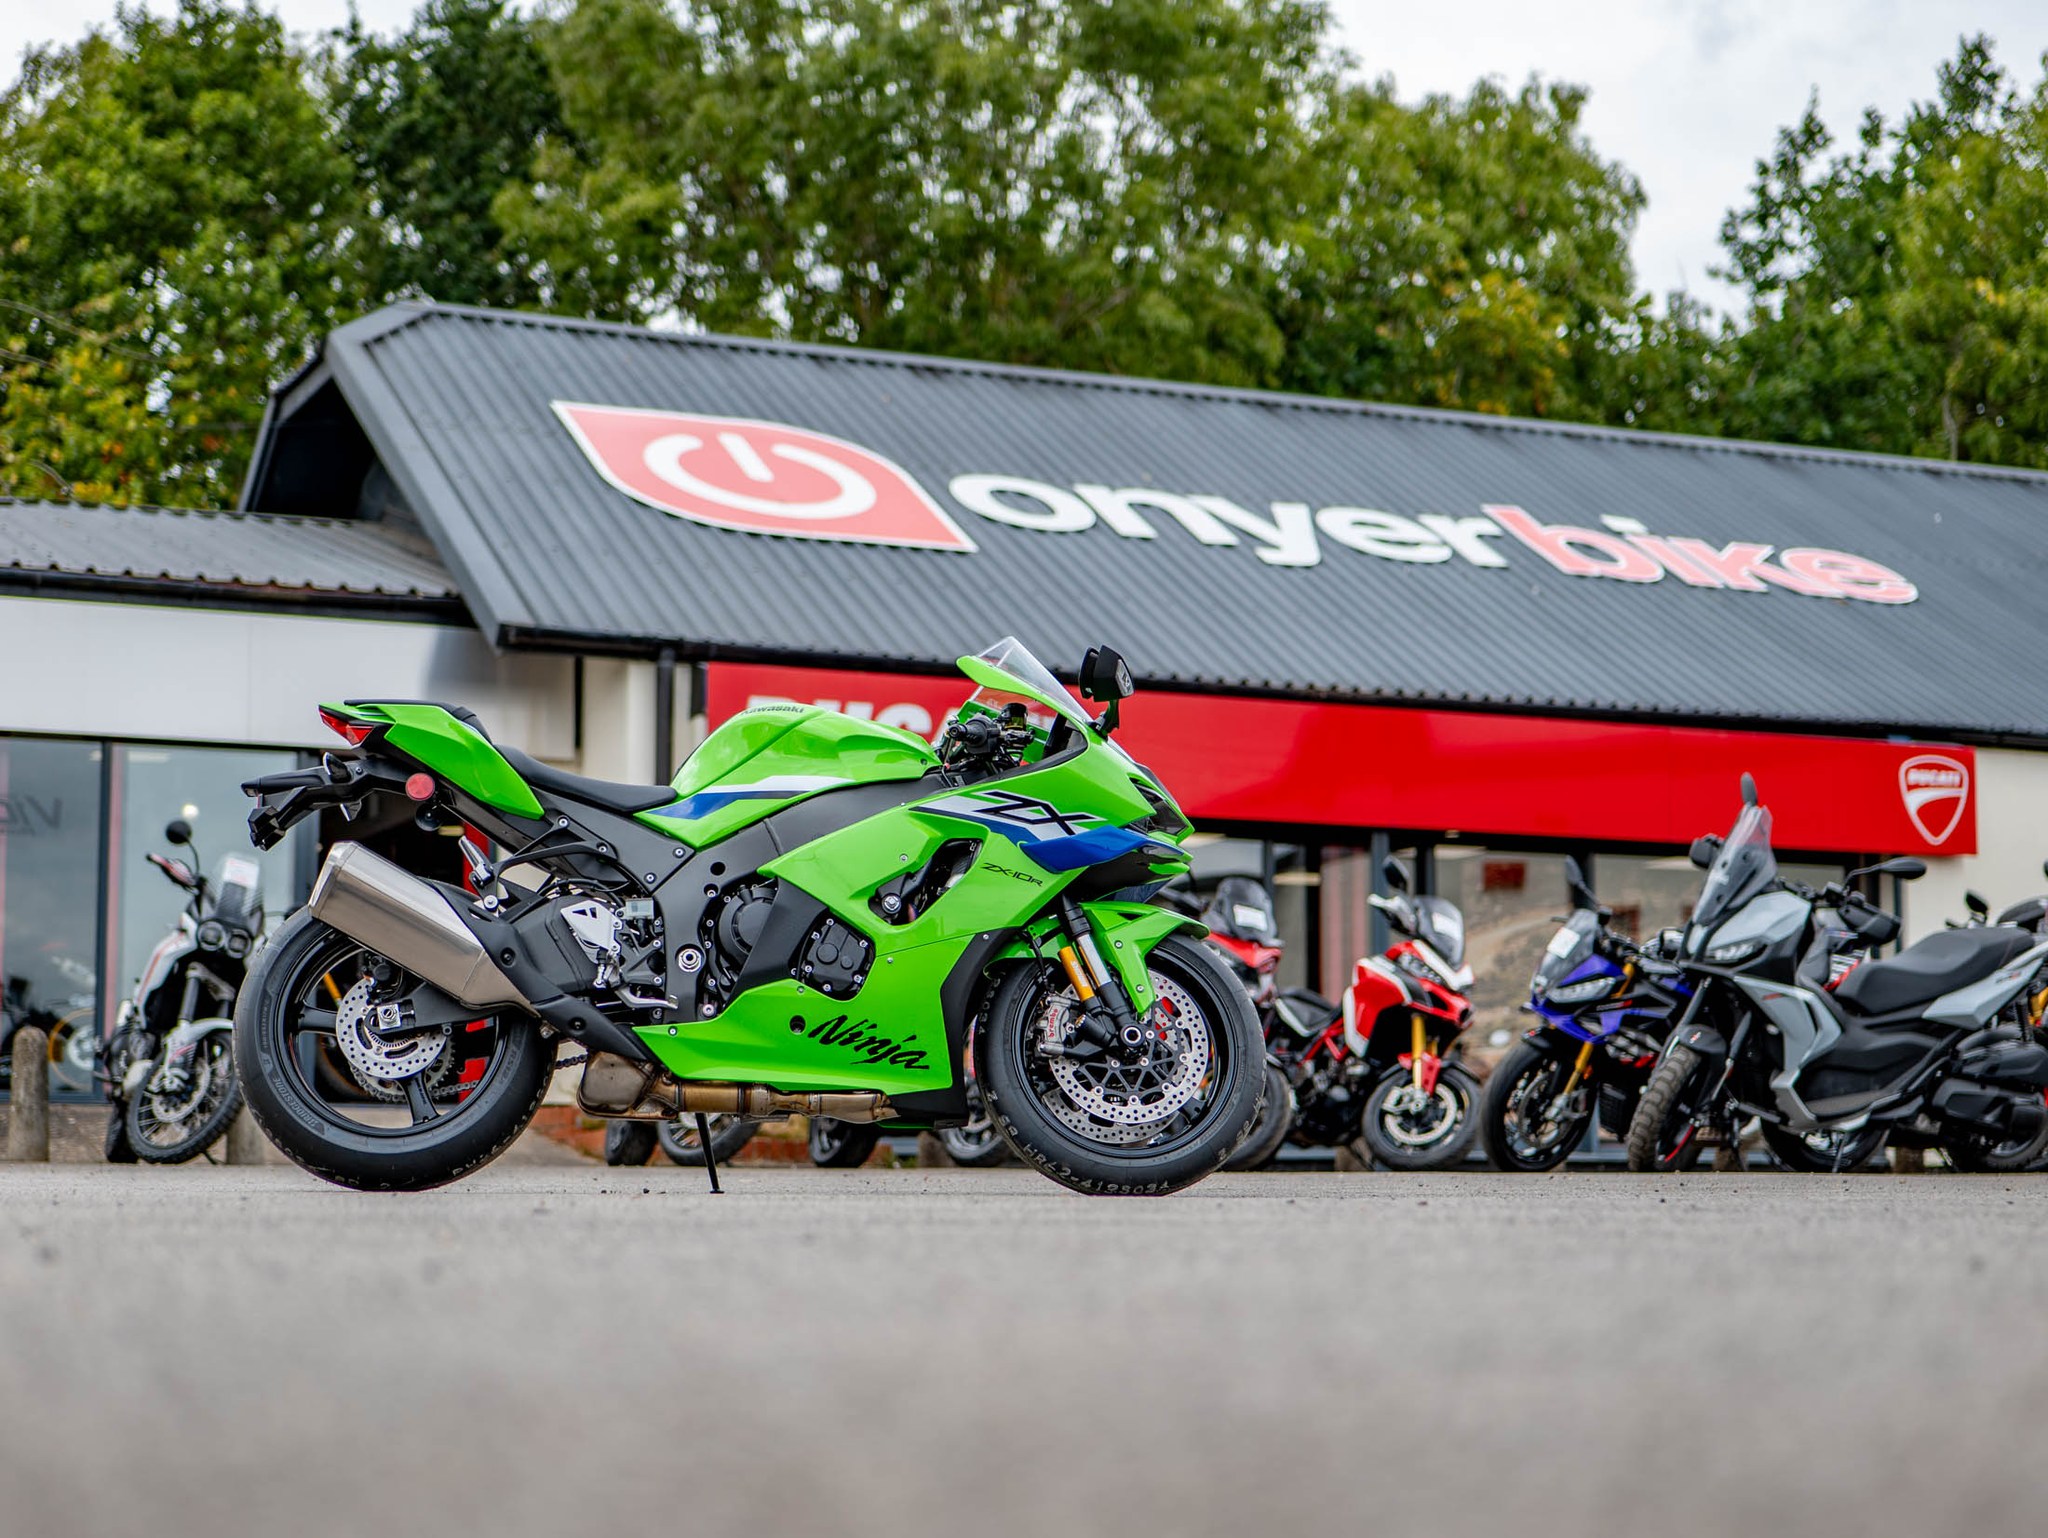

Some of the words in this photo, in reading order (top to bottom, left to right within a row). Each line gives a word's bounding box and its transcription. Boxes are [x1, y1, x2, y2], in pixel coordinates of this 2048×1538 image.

[950, 474, 1918, 604] onyerbike
[980, 861, 1044, 888] ZX-10R
[807, 1013, 930, 1070] Ninja
[1047, 1008, 1059, 1039] brembo
[272, 1077, 319, 1128] BRIDGESTONE
